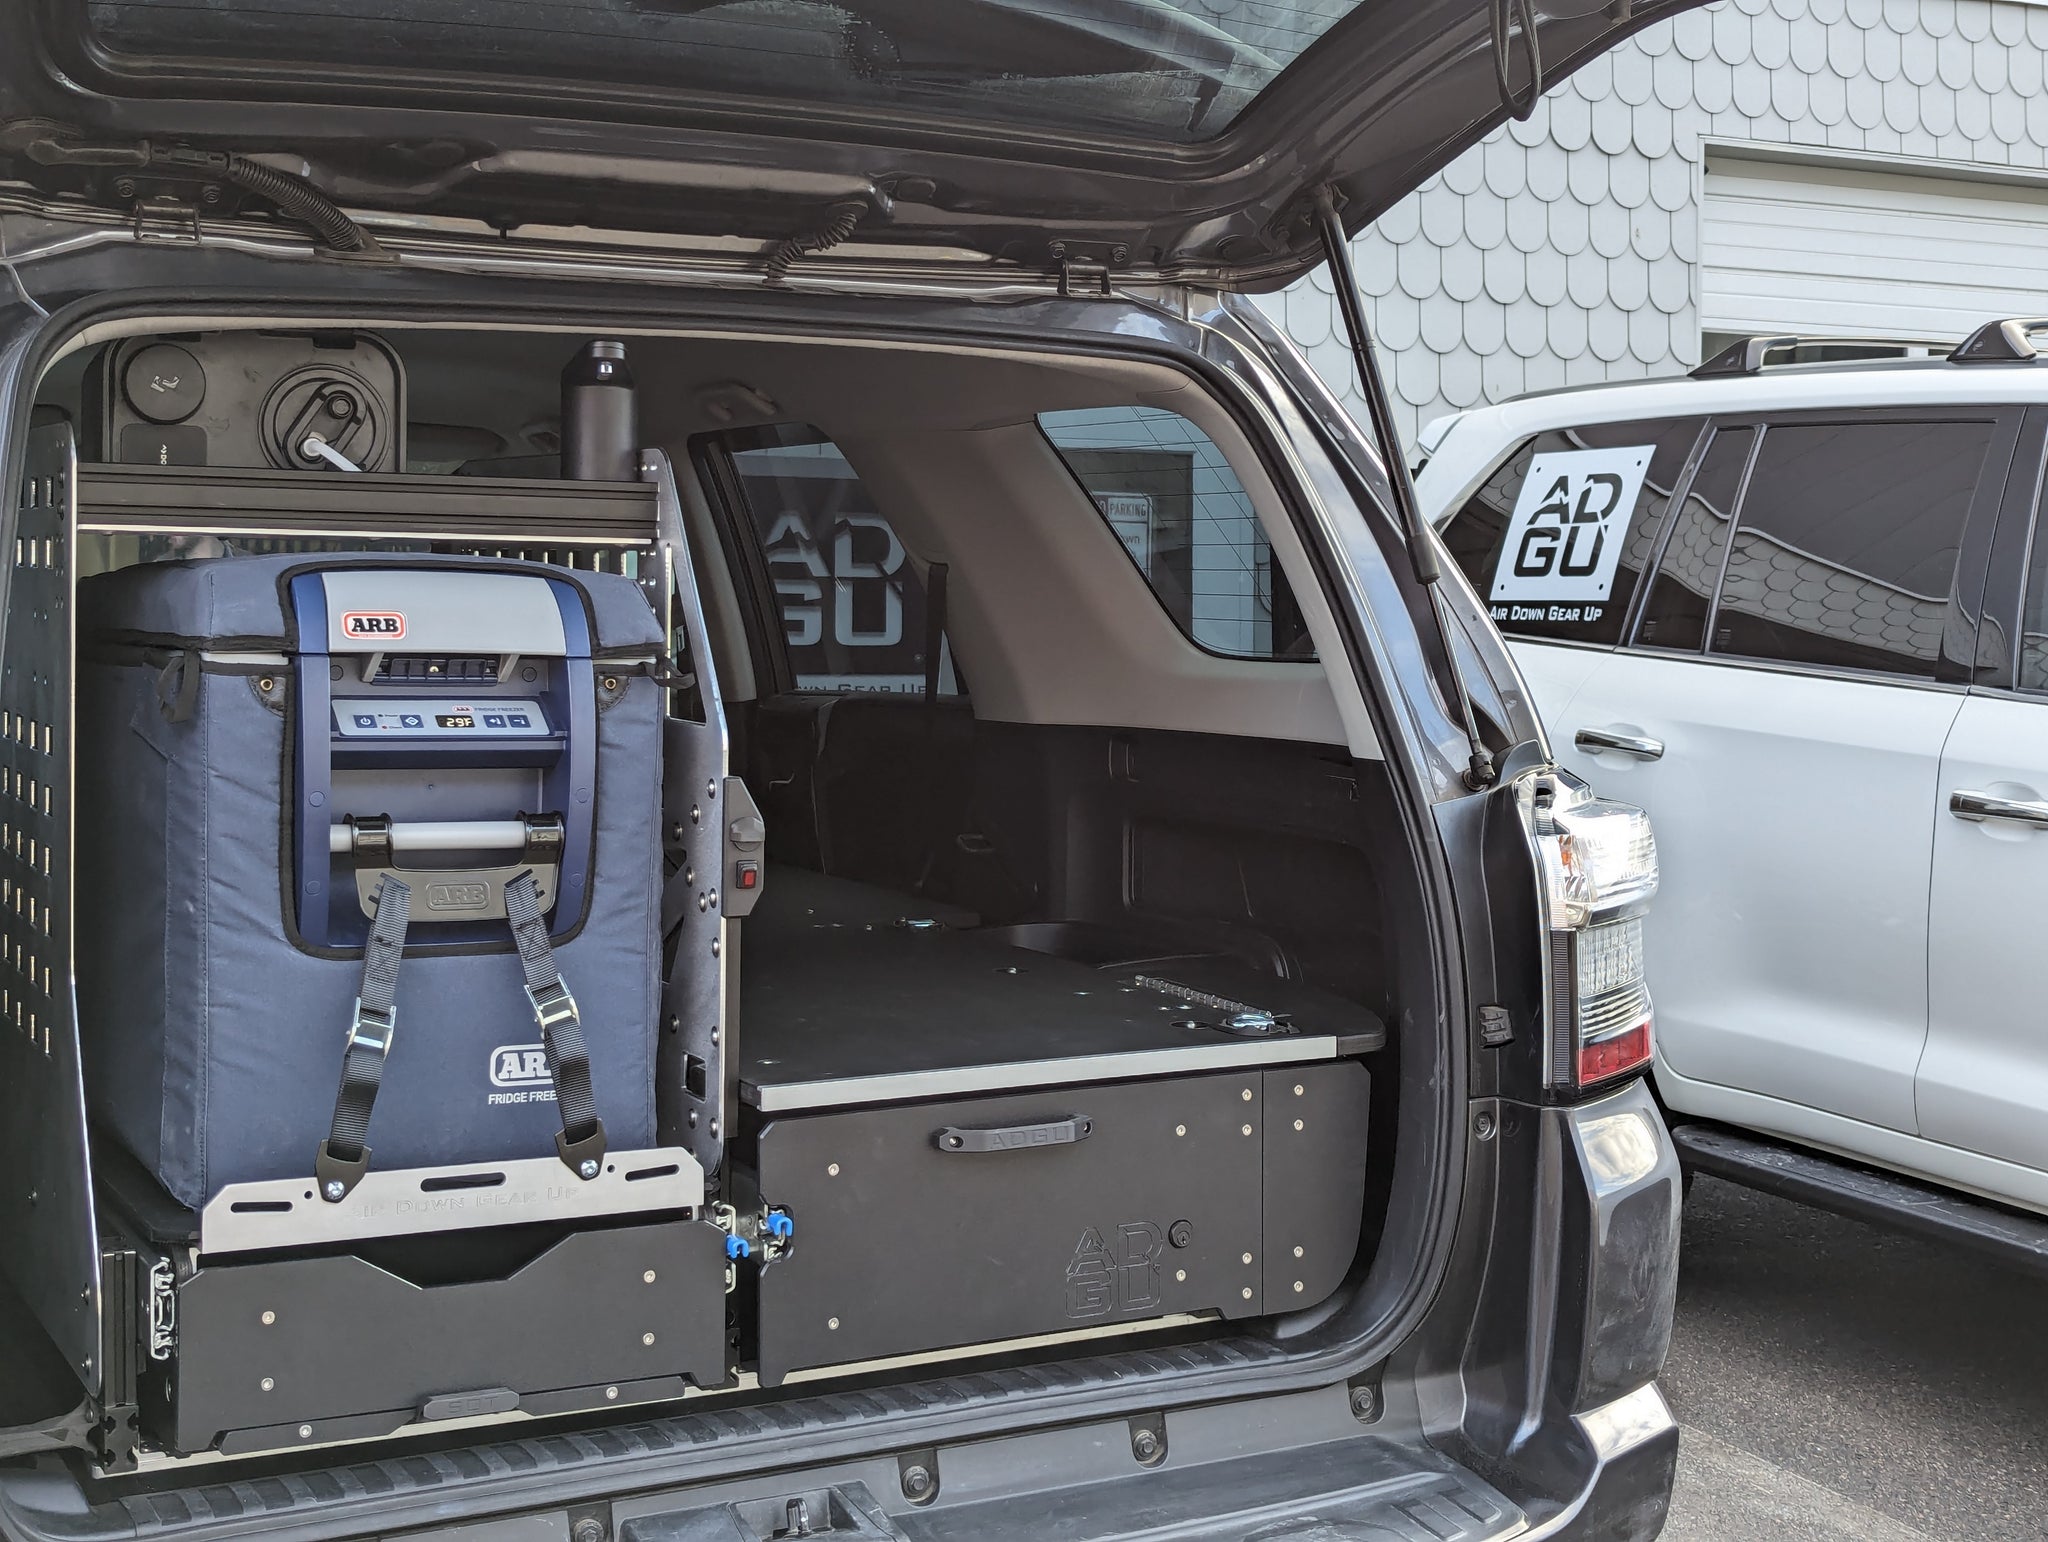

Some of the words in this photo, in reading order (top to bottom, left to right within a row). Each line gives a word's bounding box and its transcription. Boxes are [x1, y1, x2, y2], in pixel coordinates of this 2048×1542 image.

[1526, 472, 1623, 526] AD
[1110, 503, 1147, 517] PARKING
[1513, 524, 1610, 577] GU
[351, 617, 399, 633] ARB
[446, 717, 473, 728] 29F
[431, 885, 486, 903] ARB
[498, 1051, 552, 1080] AR
[488, 1092, 528, 1105] FRIDGE
[529, 1089, 559, 1102] FREE
